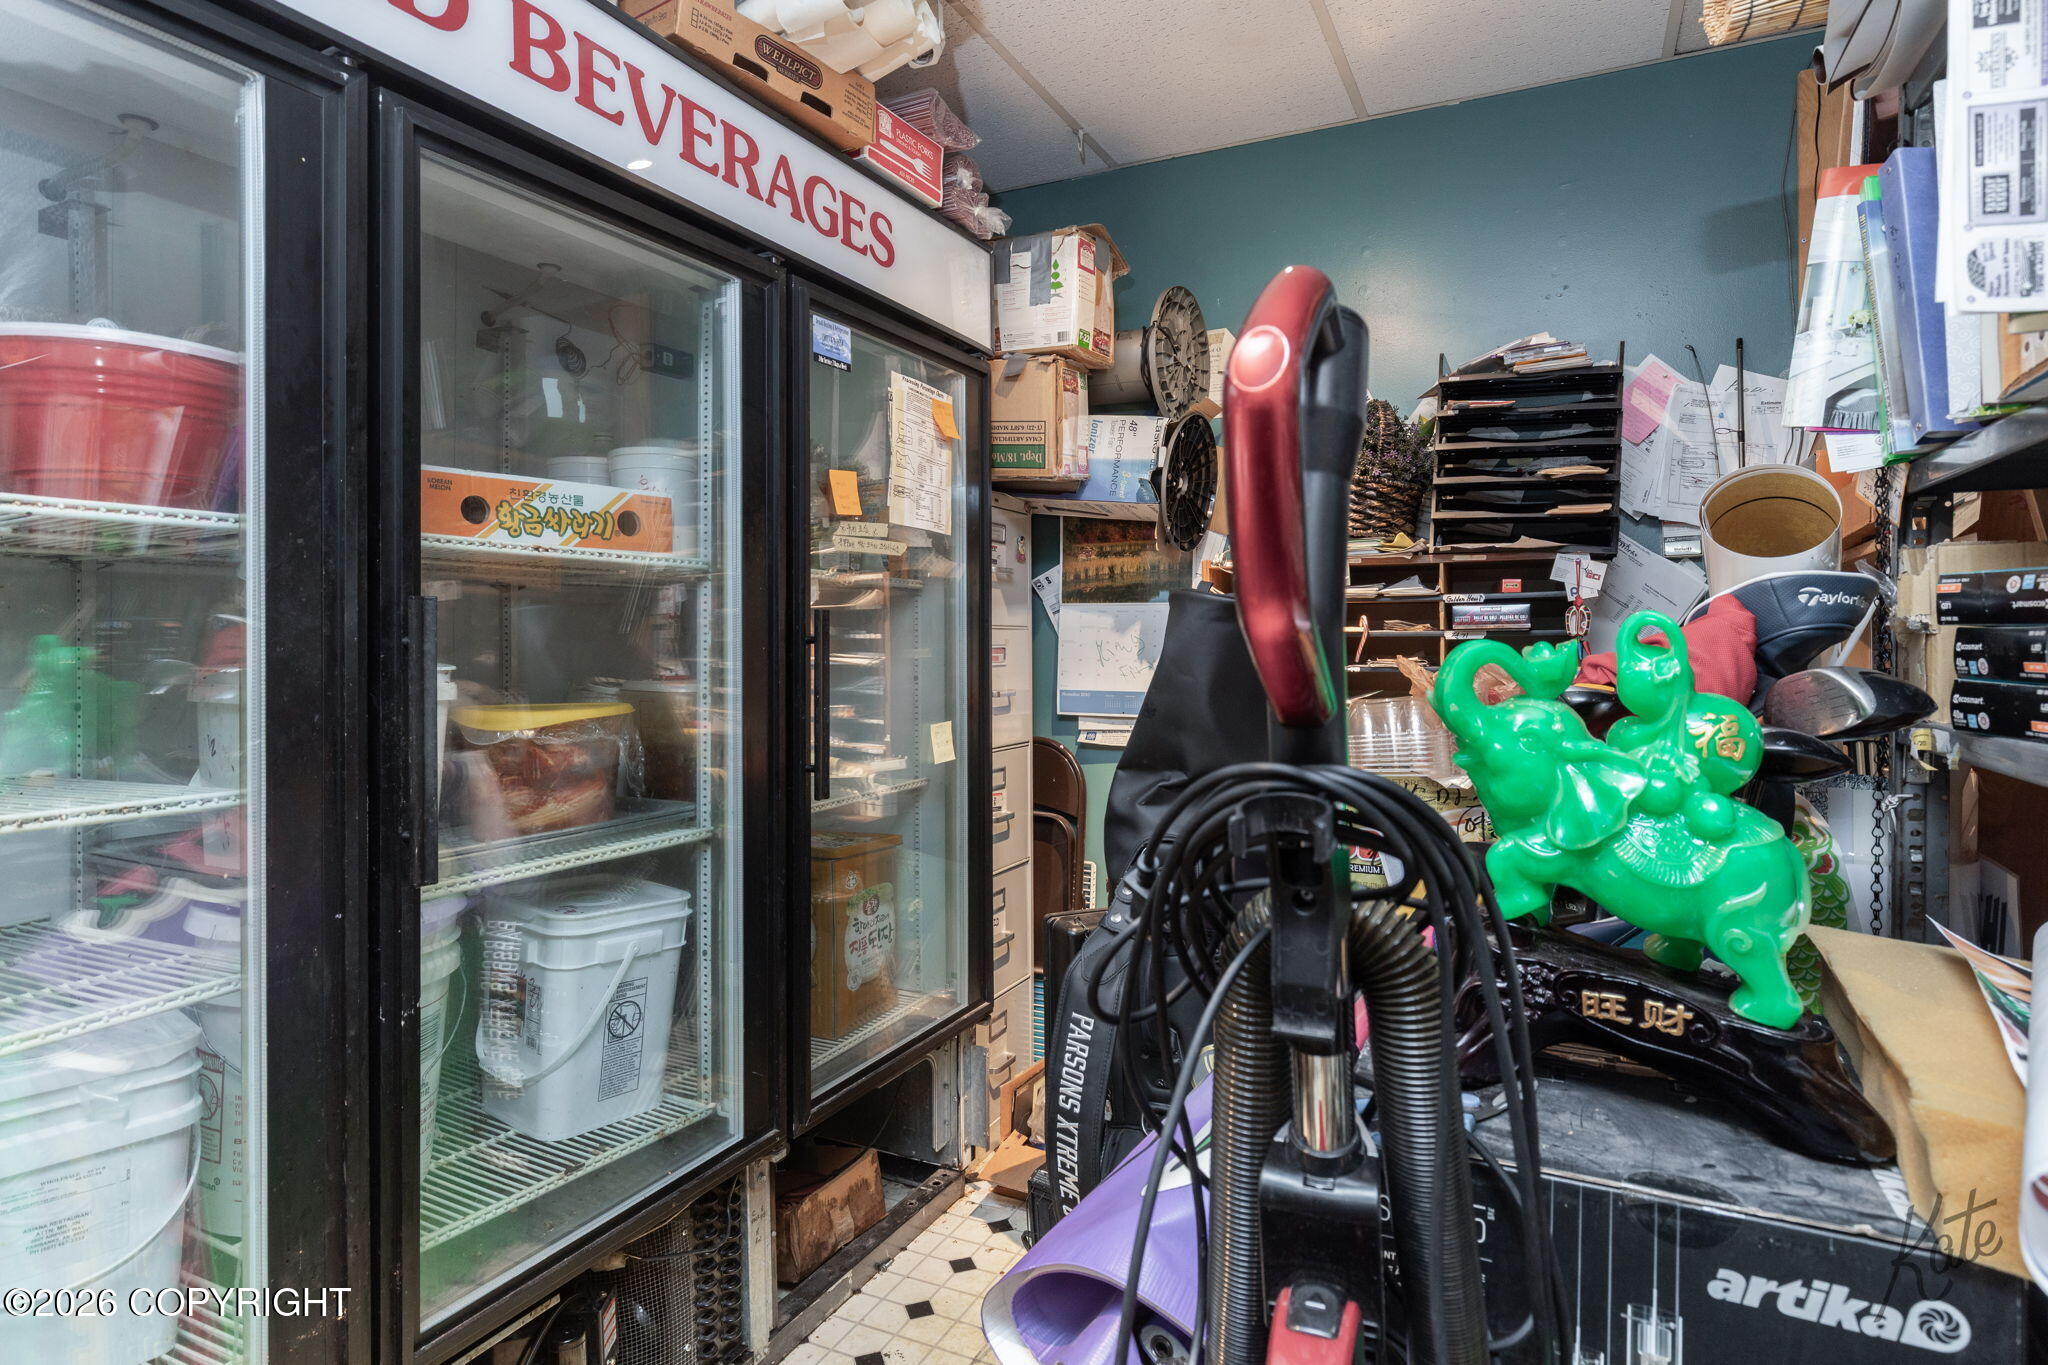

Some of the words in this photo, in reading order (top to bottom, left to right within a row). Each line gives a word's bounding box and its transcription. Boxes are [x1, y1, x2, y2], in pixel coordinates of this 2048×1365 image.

[761, 41, 817, 81] WELLPICT
[508, 0, 896, 268] BEVERAGES
[896, 128, 917, 149] PLASTIC
[917, 142, 934, 160] FORKS
[1089, 419, 1103, 454] Ionizer
[1129, 420, 1138, 437] 48"
[1152, 417, 1163, 454] Lasko
[1019, 449, 1043, 464] Dept.
[1109, 419, 1127, 497] PERFORMANCE
[427, 477, 453, 486] KOREAN
[509, 487, 584, 507] 친환경농산물
[1797, 586, 1869, 608] Taylor
[1958, 696, 1985, 705] ecosmart
[1687, 712, 1746, 762] 福
[1350, 864, 1380, 874] REMIUM
[1580, 989, 1694, 1037] 旺财
[1058, 1011, 1095, 1113] PARSONS
[1055, 1114, 1081, 1205] XTREME
[1706, 1268, 1902, 1342] artika
